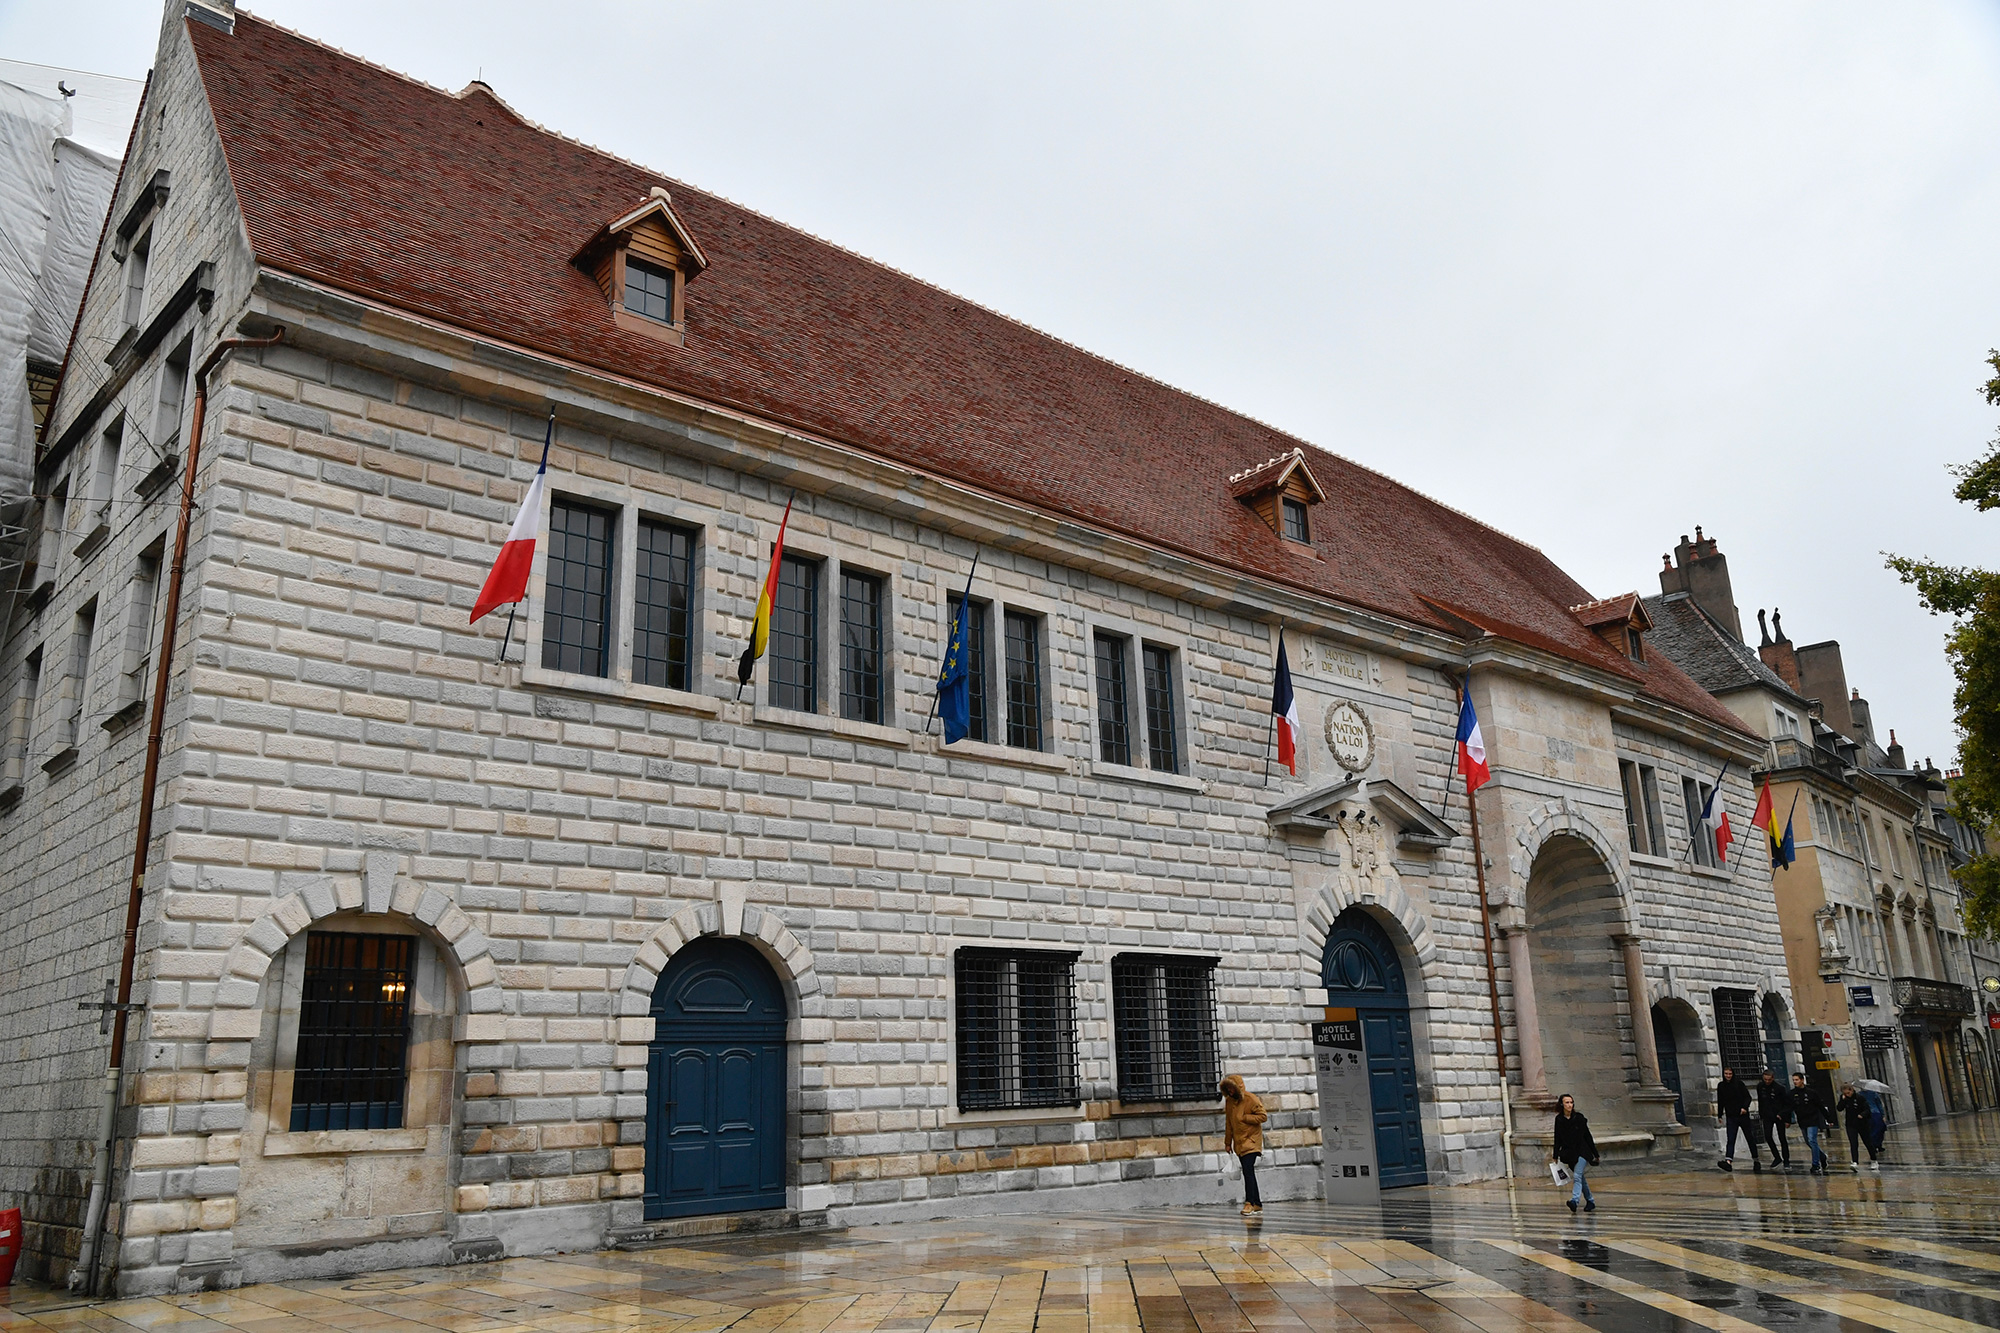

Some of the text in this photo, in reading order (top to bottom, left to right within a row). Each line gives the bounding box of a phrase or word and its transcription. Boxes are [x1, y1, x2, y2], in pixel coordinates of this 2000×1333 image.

[1325, 648, 1356, 666] HOTEL
[1321, 660, 1363, 681] DE VILLE
[1341, 711, 1353, 723] LA
[1333, 721, 1363, 736] NATION
[1336, 733, 1363, 748] LA LOI
[1321, 1025, 1350, 1034] HOTEL
[1317, 1033, 1356, 1042] DE VILLE
